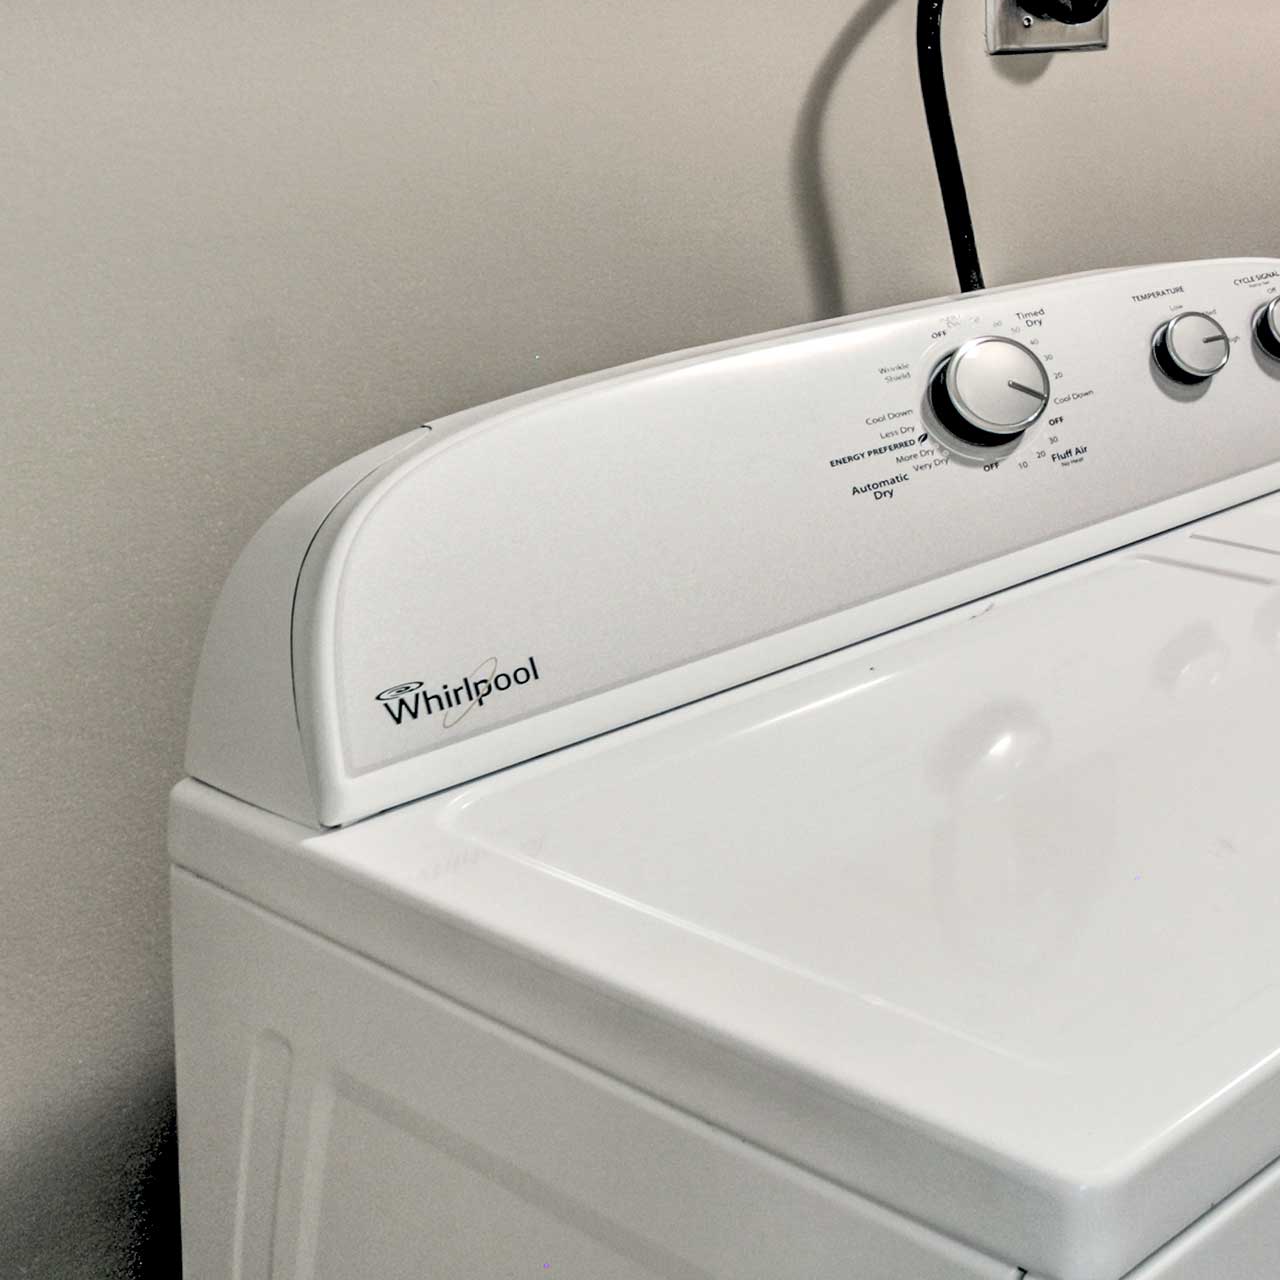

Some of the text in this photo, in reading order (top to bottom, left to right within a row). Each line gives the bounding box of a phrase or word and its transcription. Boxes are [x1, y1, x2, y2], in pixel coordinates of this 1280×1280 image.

[1233, 275, 1255, 286] CYCLE
[1256, 270, 1280, 282] SIGNAL
[1132, 285, 1185, 302] TEMPERATURE
[1016, 308, 1045, 321] Timed
[1025, 318, 1043, 328] Dry
[1044, 354, 1053, 362] 30
[1053, 371, 1063, 380] 20
[1053, 389, 1094, 405] Cool Down
[865, 408, 913, 426] Cool Down
[1048, 416, 1064, 426] OFF
[880, 426, 915, 440] Less Dry
[829, 439, 916, 468] ENERGY PREFERRED
[895, 447, 935, 464] More Dry
[1036, 450, 1046, 459] 20
[1051, 446, 1088, 463] Fluff Air
[913, 456, 950, 472] Very Dry
[983, 462, 999, 472] OFF
[1019, 461, 1028, 470] 10
[851, 473, 910, 496] Automatic
[873, 488, 895, 501] Dry
[383, 656, 540, 726] Whirlpool
